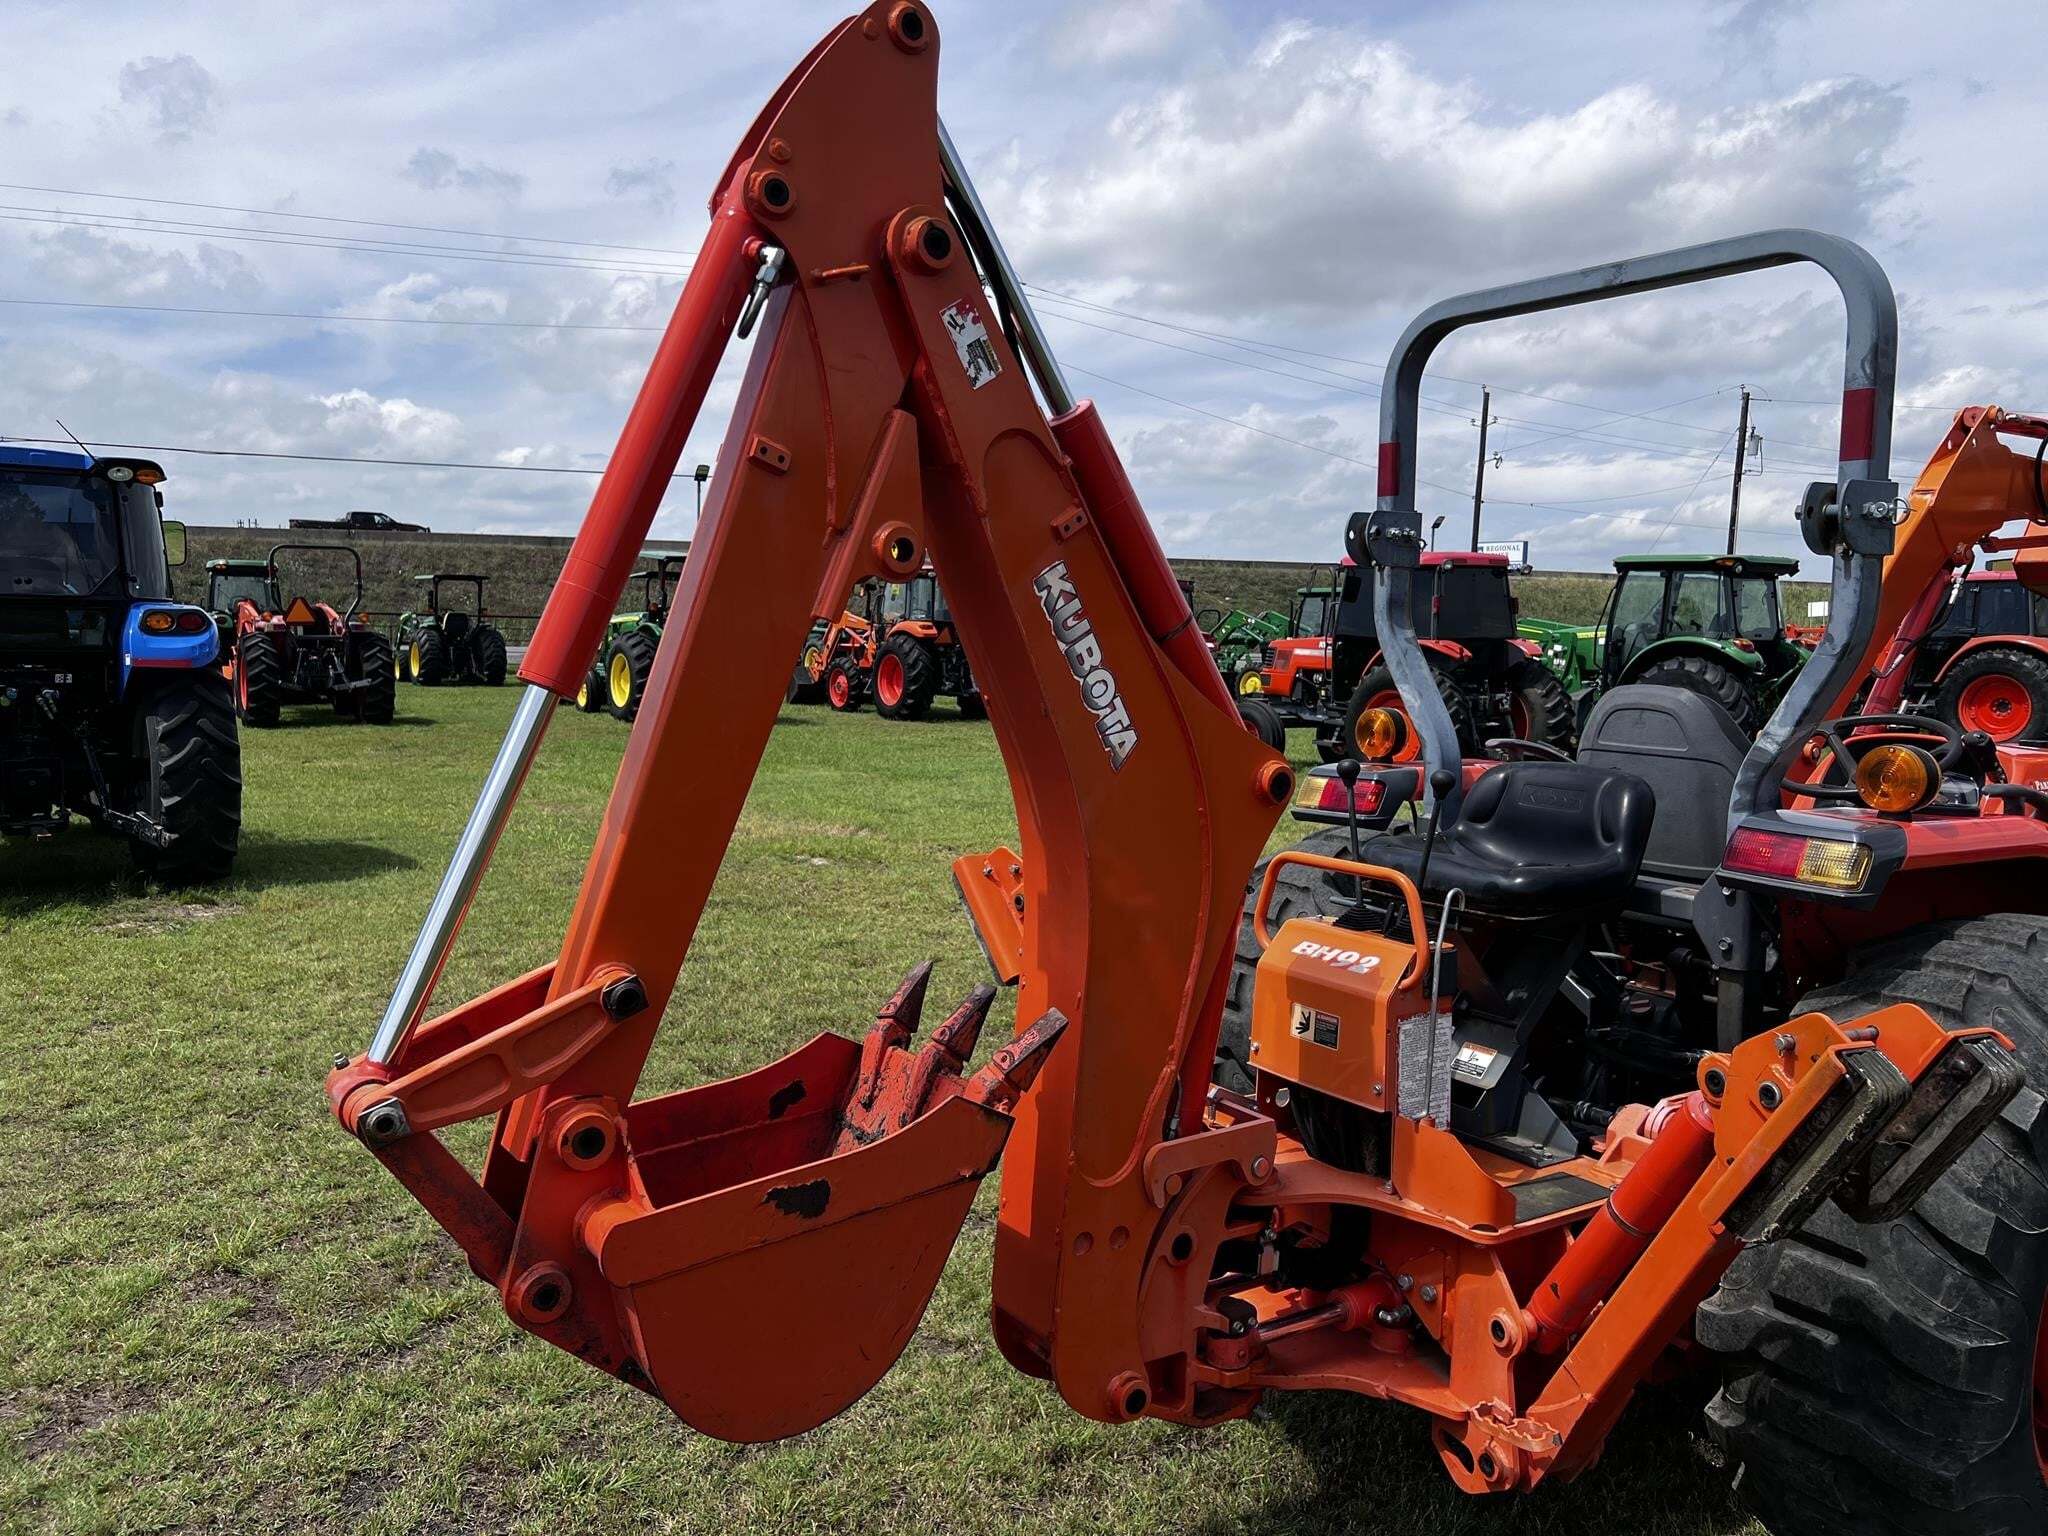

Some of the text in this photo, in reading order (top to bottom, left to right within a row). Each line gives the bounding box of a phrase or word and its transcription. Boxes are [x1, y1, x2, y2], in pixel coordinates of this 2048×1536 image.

[1486, 544, 1520, 552] REGIONAL
[1034, 560, 1139, 773] KUBOTA
[1291, 940, 1381, 975] BH92
